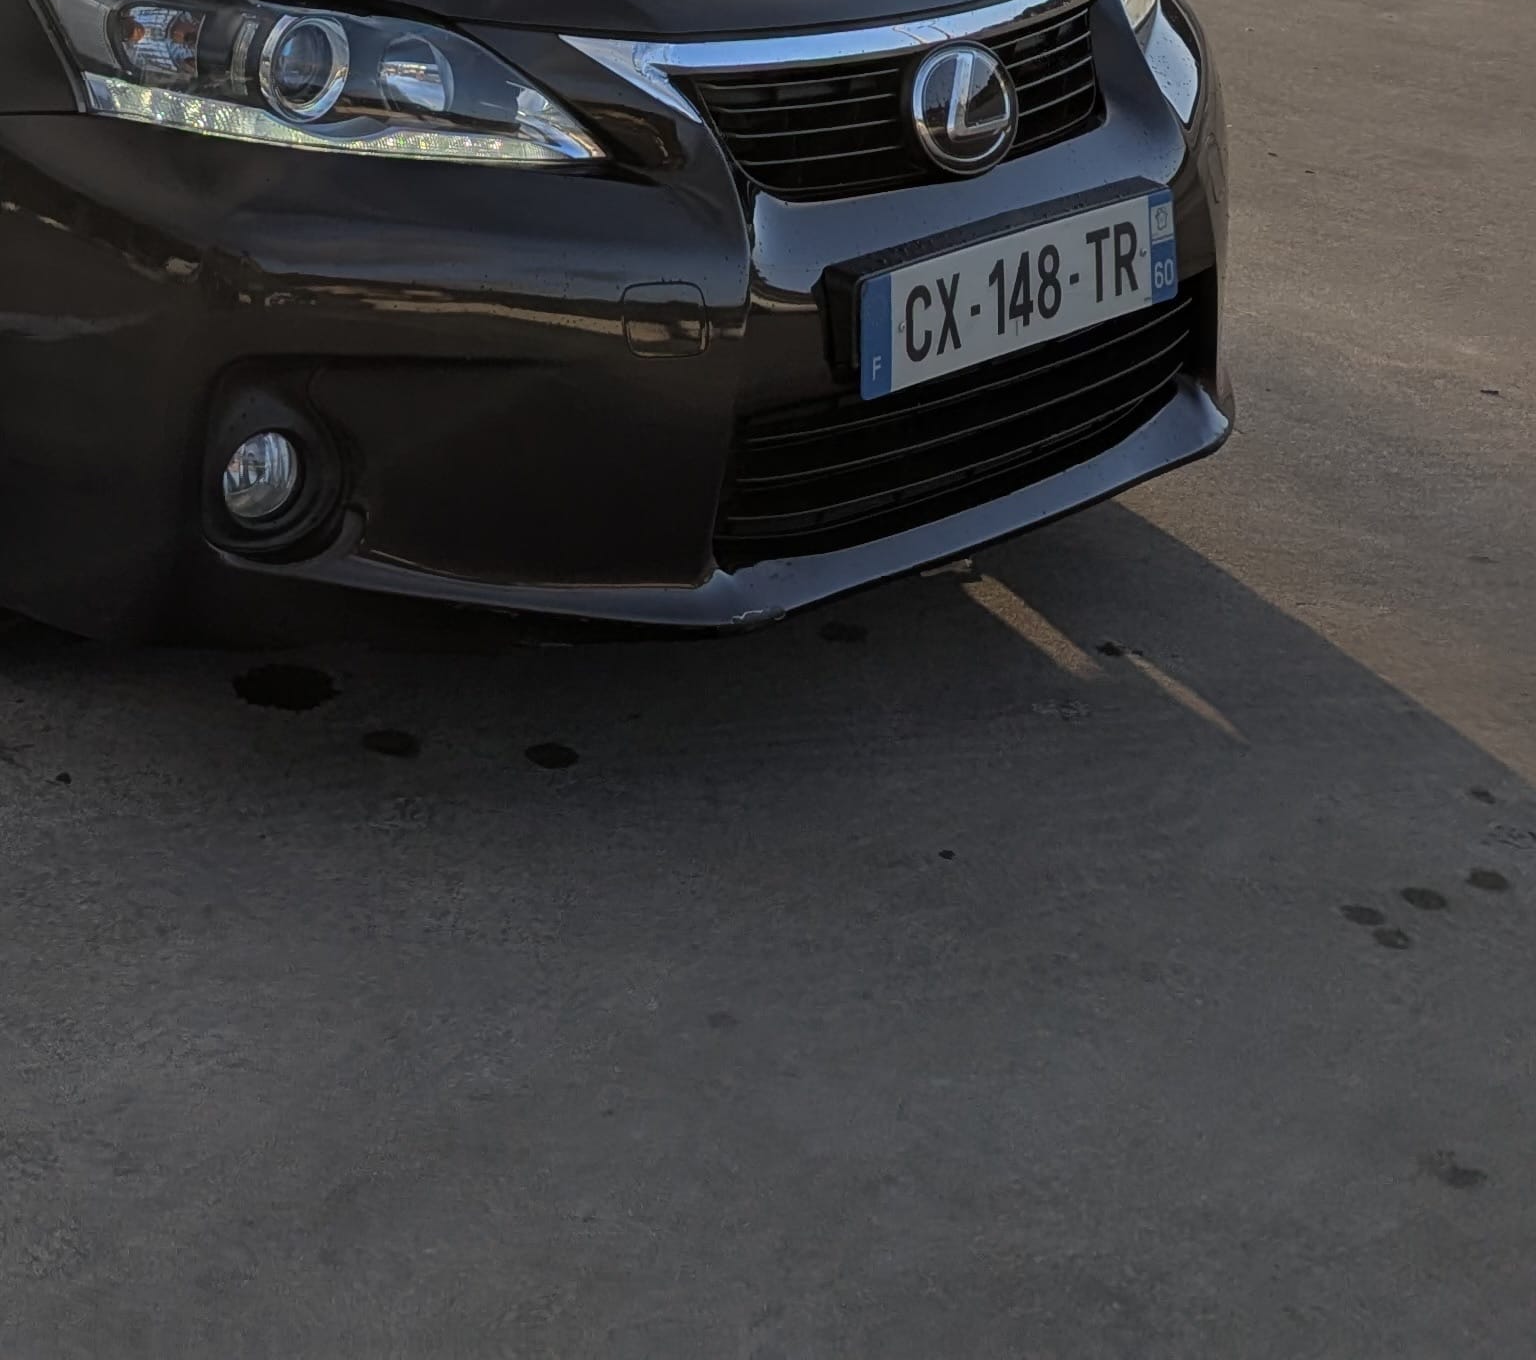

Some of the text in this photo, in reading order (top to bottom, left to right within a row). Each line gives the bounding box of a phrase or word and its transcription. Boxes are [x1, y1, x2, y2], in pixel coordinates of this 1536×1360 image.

[1154, 258, 1174, 289] 60
[905, 221, 1139, 362] CX-148-TR
[872, 355, 882, 381] F
